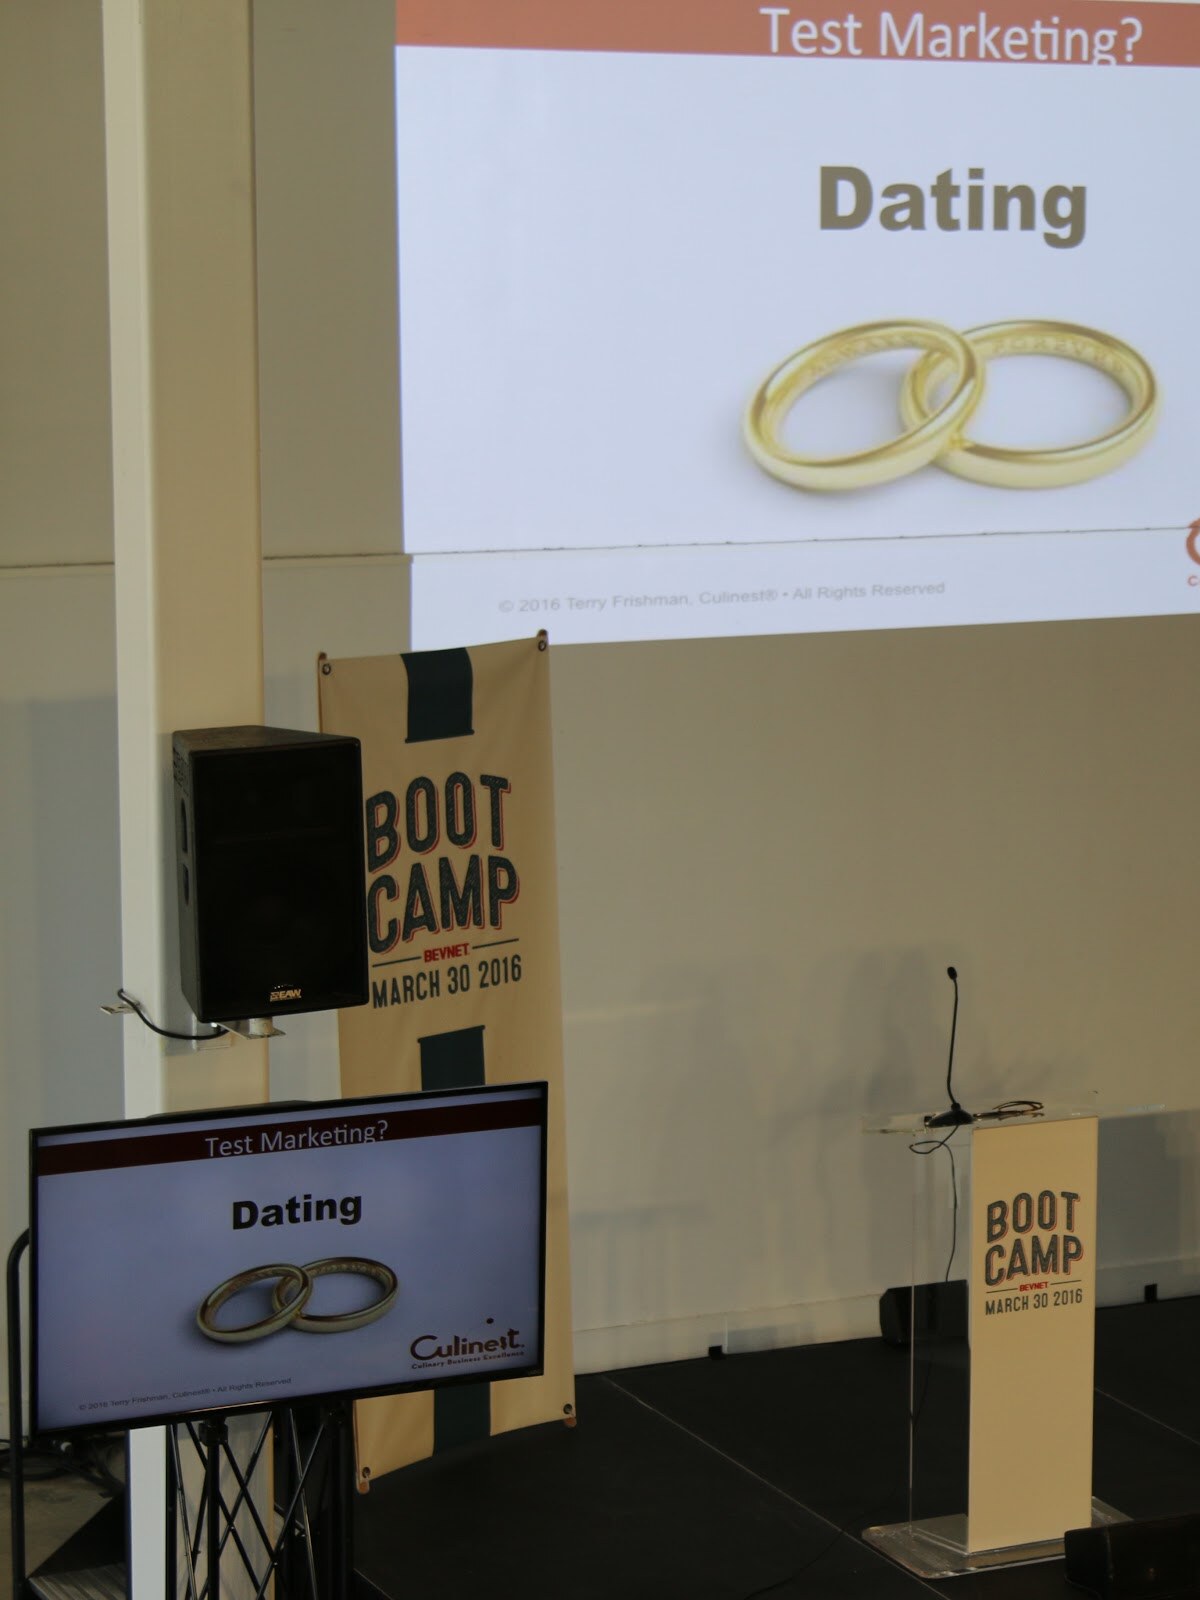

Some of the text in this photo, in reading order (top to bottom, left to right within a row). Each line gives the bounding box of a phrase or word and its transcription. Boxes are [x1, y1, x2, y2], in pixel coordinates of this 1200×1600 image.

[760, 7, 1144, 66] Test Marketing?
[820, 166, 1087, 249] Dating
[519, 599, 561, 612] 2016
[567, 598, 607, 612] Terry
[792, 587, 812, 601] All
[818, 585, 867, 601] Rights
[872, 582, 946, 597] Reserved
[365, 772, 512, 873] BOOT
[367, 855, 520, 954] CAMP
[424, 943, 470, 963] BEVNET
[372, 955, 522, 1009] MARCH 30 2016
[205, 1120, 389, 1157] Test Marketing?
[232, 1194, 363, 1230] Dating
[987, 1190, 1080, 1243] BOOT
[985, 1234, 1084, 1287] CAMP
[985, 1288, 1083, 1316] MARCH 30 2016
[1018, 1281, 1050, 1292] BEVNET
[255, 1377, 292, 1388] Reserved
[411, 1361, 445, 1370] Culinary
